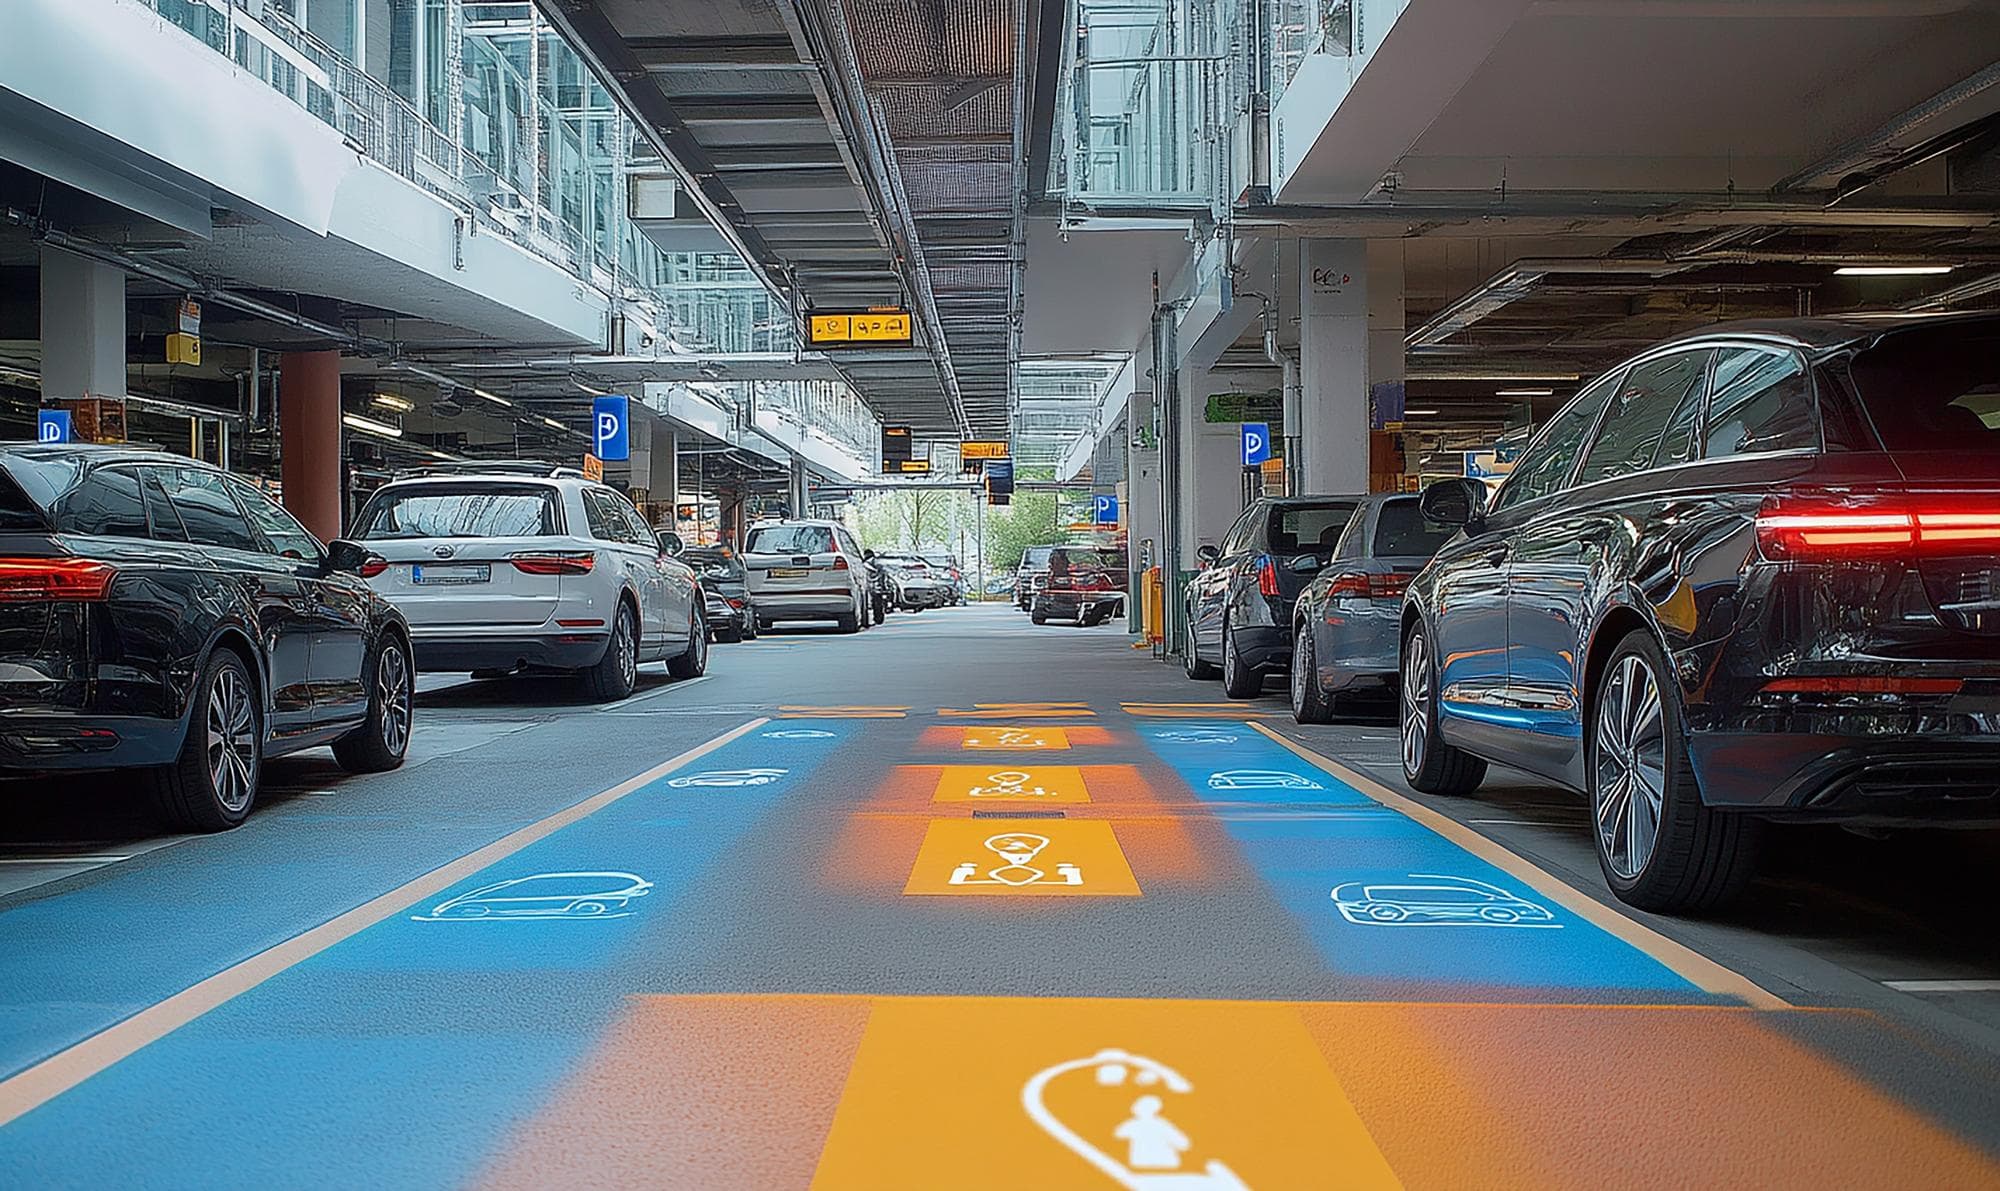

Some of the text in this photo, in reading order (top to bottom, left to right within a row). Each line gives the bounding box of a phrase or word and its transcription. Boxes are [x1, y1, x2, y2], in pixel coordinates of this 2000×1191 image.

[598, 412, 619, 458] P
[1245, 432, 1262, 465] P
[1097, 496, 1109, 522] P
